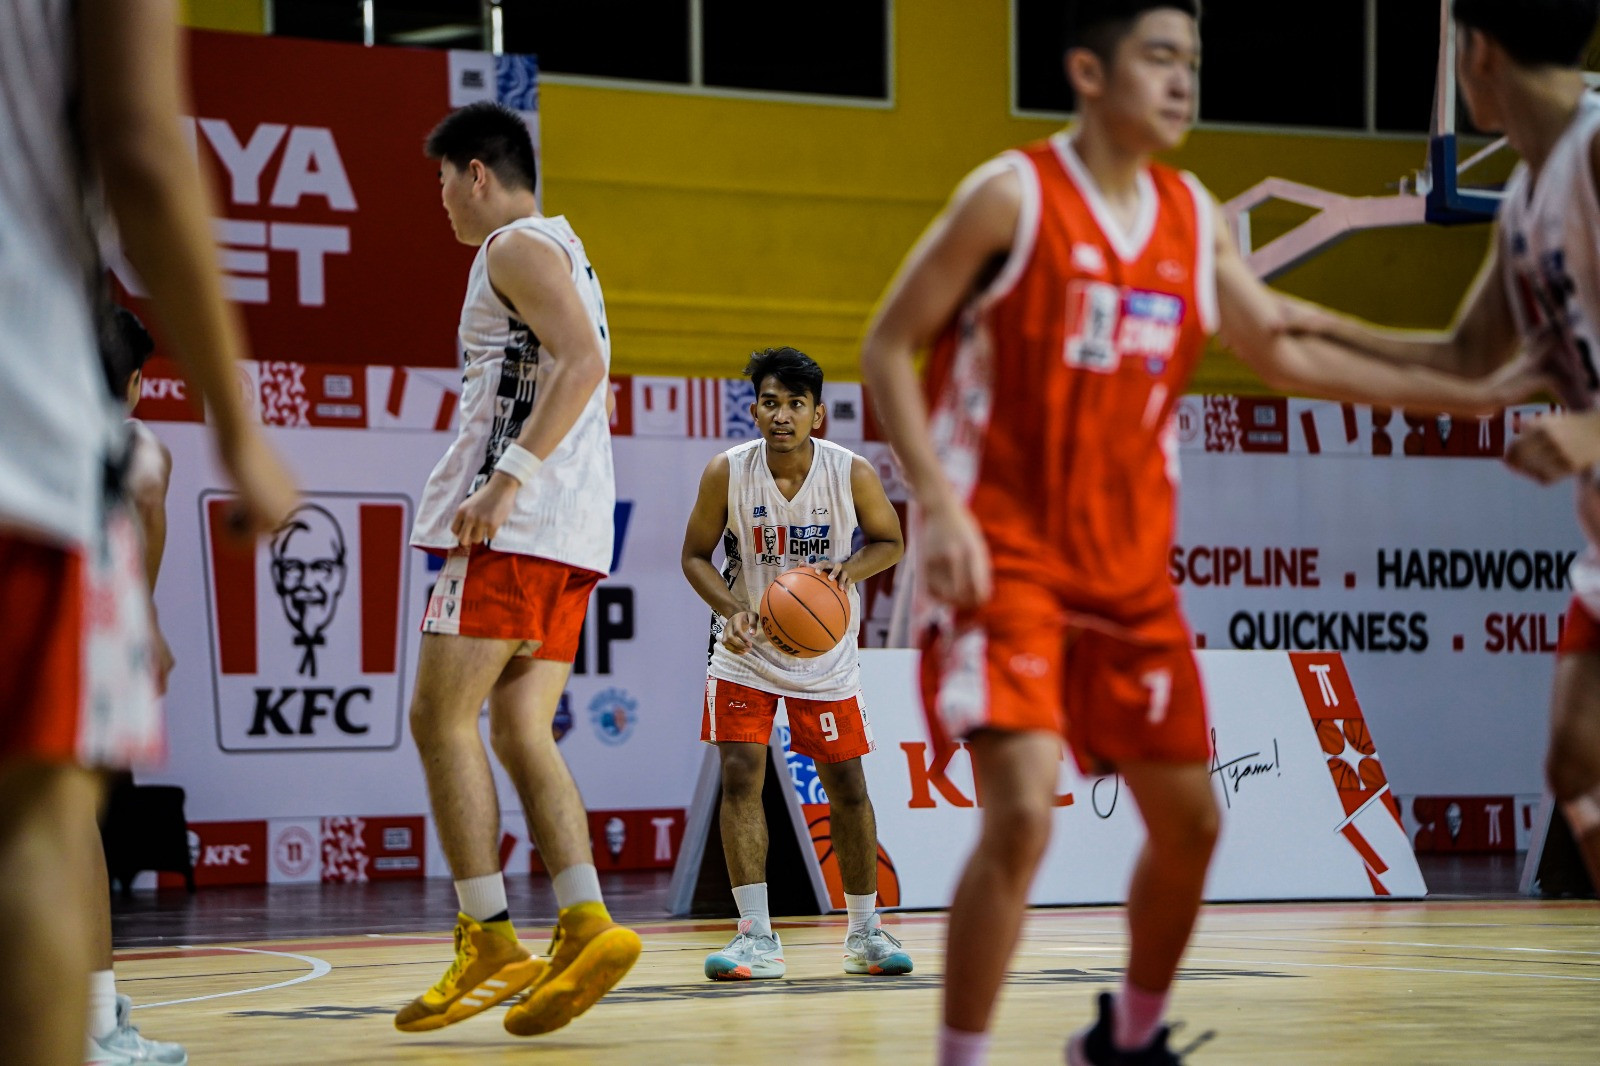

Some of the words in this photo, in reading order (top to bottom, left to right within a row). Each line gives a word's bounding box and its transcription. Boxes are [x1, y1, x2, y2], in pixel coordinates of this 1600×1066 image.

[180, 116, 358, 211] YA
[141, 378, 186, 399] KFC
[804, 527, 823, 538] DBL
[761, 553, 781, 565] KFC
[789, 538, 831, 556] CAMP
[1168, 546, 1320, 588] SCIPLINE
[1377, 549, 1577, 590] HARDWORK
[1229, 611, 1428, 652] QUICKNESS
[247, 687, 372, 735] KFC
[819, 711, 839, 742] 9
[204, 844, 250, 866] KFC
